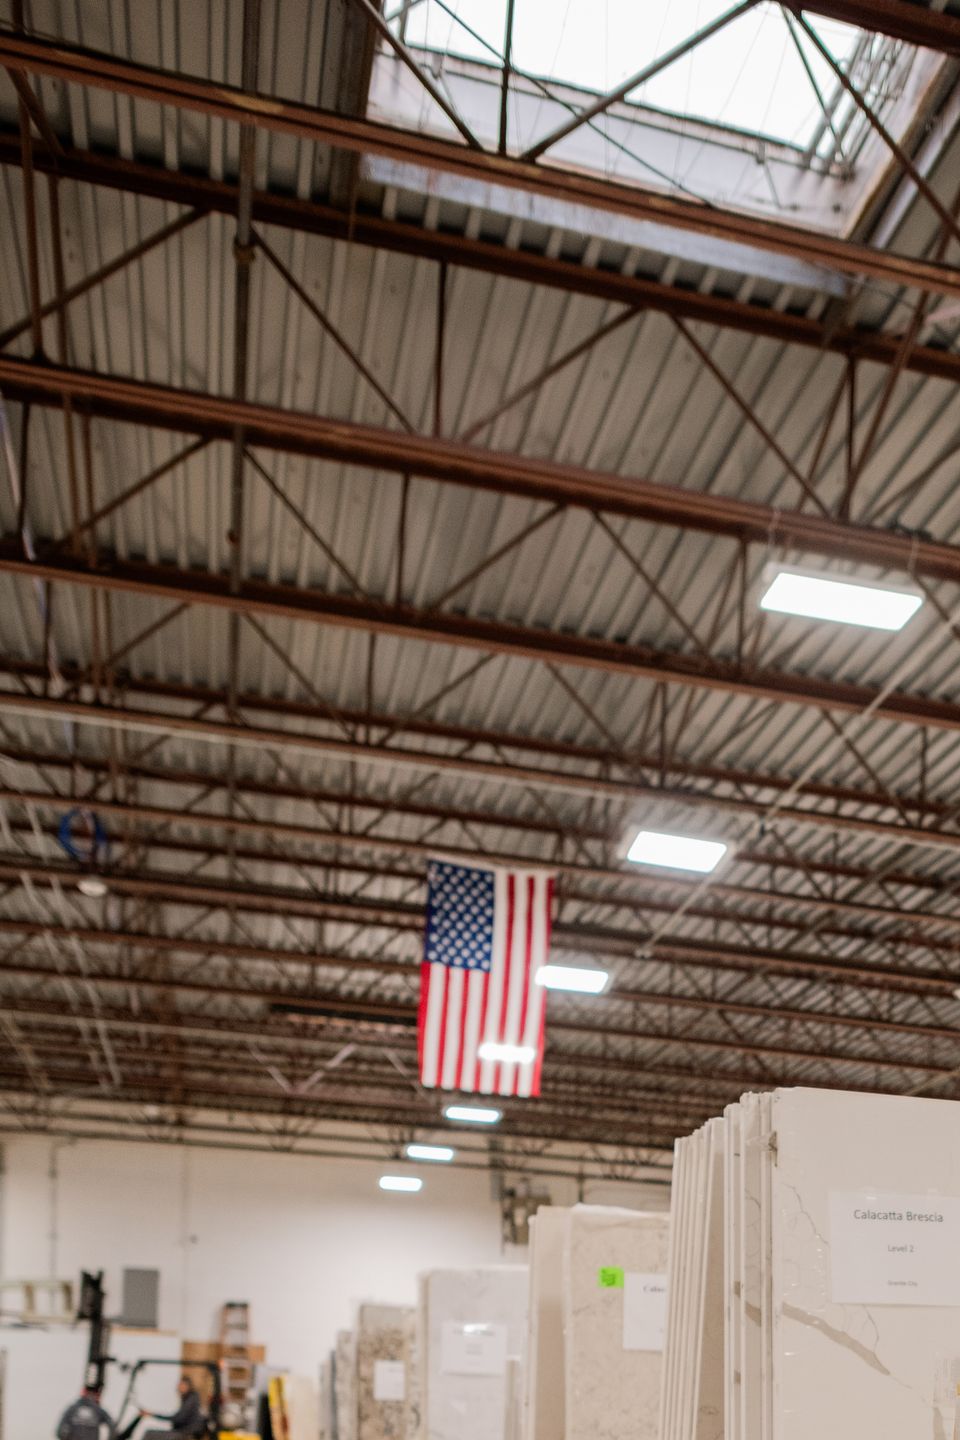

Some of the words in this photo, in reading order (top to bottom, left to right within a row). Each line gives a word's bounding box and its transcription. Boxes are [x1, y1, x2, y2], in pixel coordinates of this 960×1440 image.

[853, 1209, 903, 1221] Calacatta
[906, 1211, 944, 1223] Brescia
[888, 1244, 907, 1253] Level
[909, 1245, 915, 1253] 2
